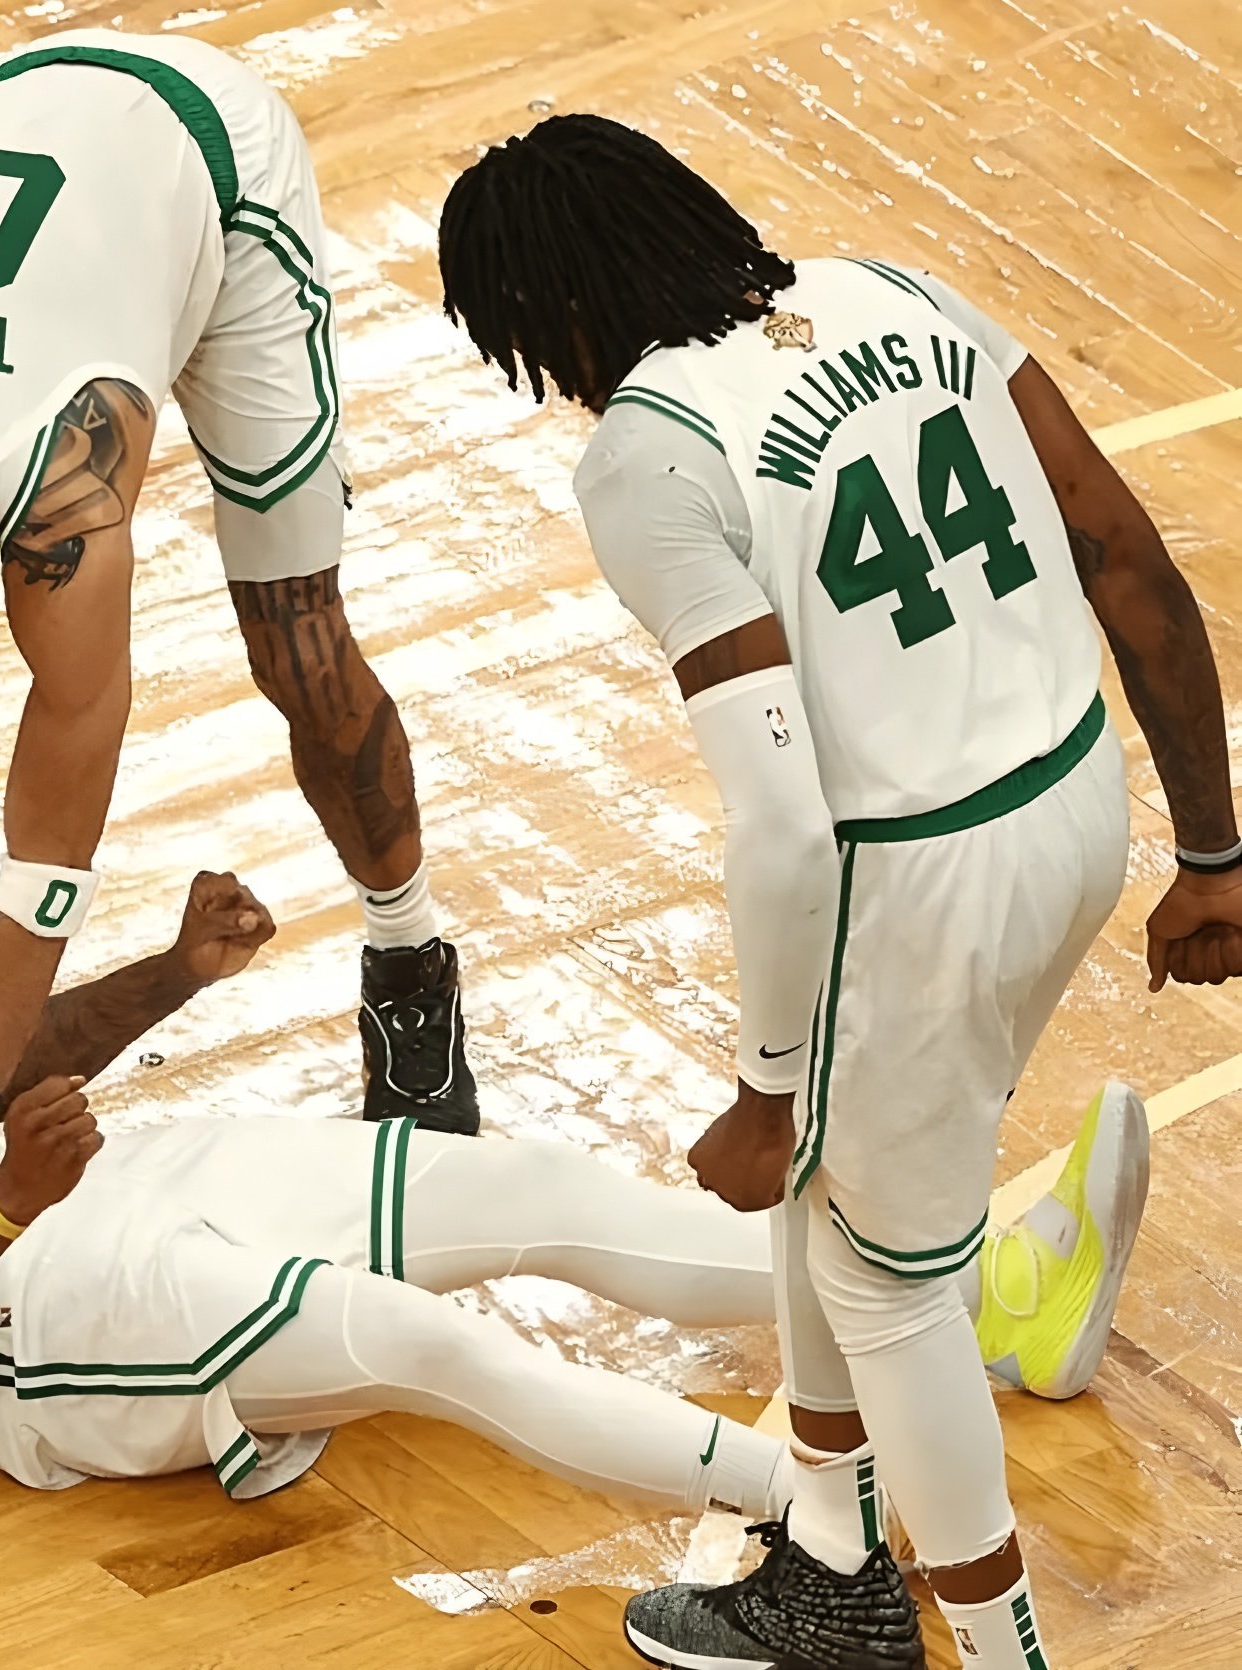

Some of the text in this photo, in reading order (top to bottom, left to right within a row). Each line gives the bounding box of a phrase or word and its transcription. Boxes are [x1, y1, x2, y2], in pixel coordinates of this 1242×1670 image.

[755, 333, 976, 491] WILLIAMS III
[816, 404, 1038, 650] 44
[35, 879, 78, 928] 0
